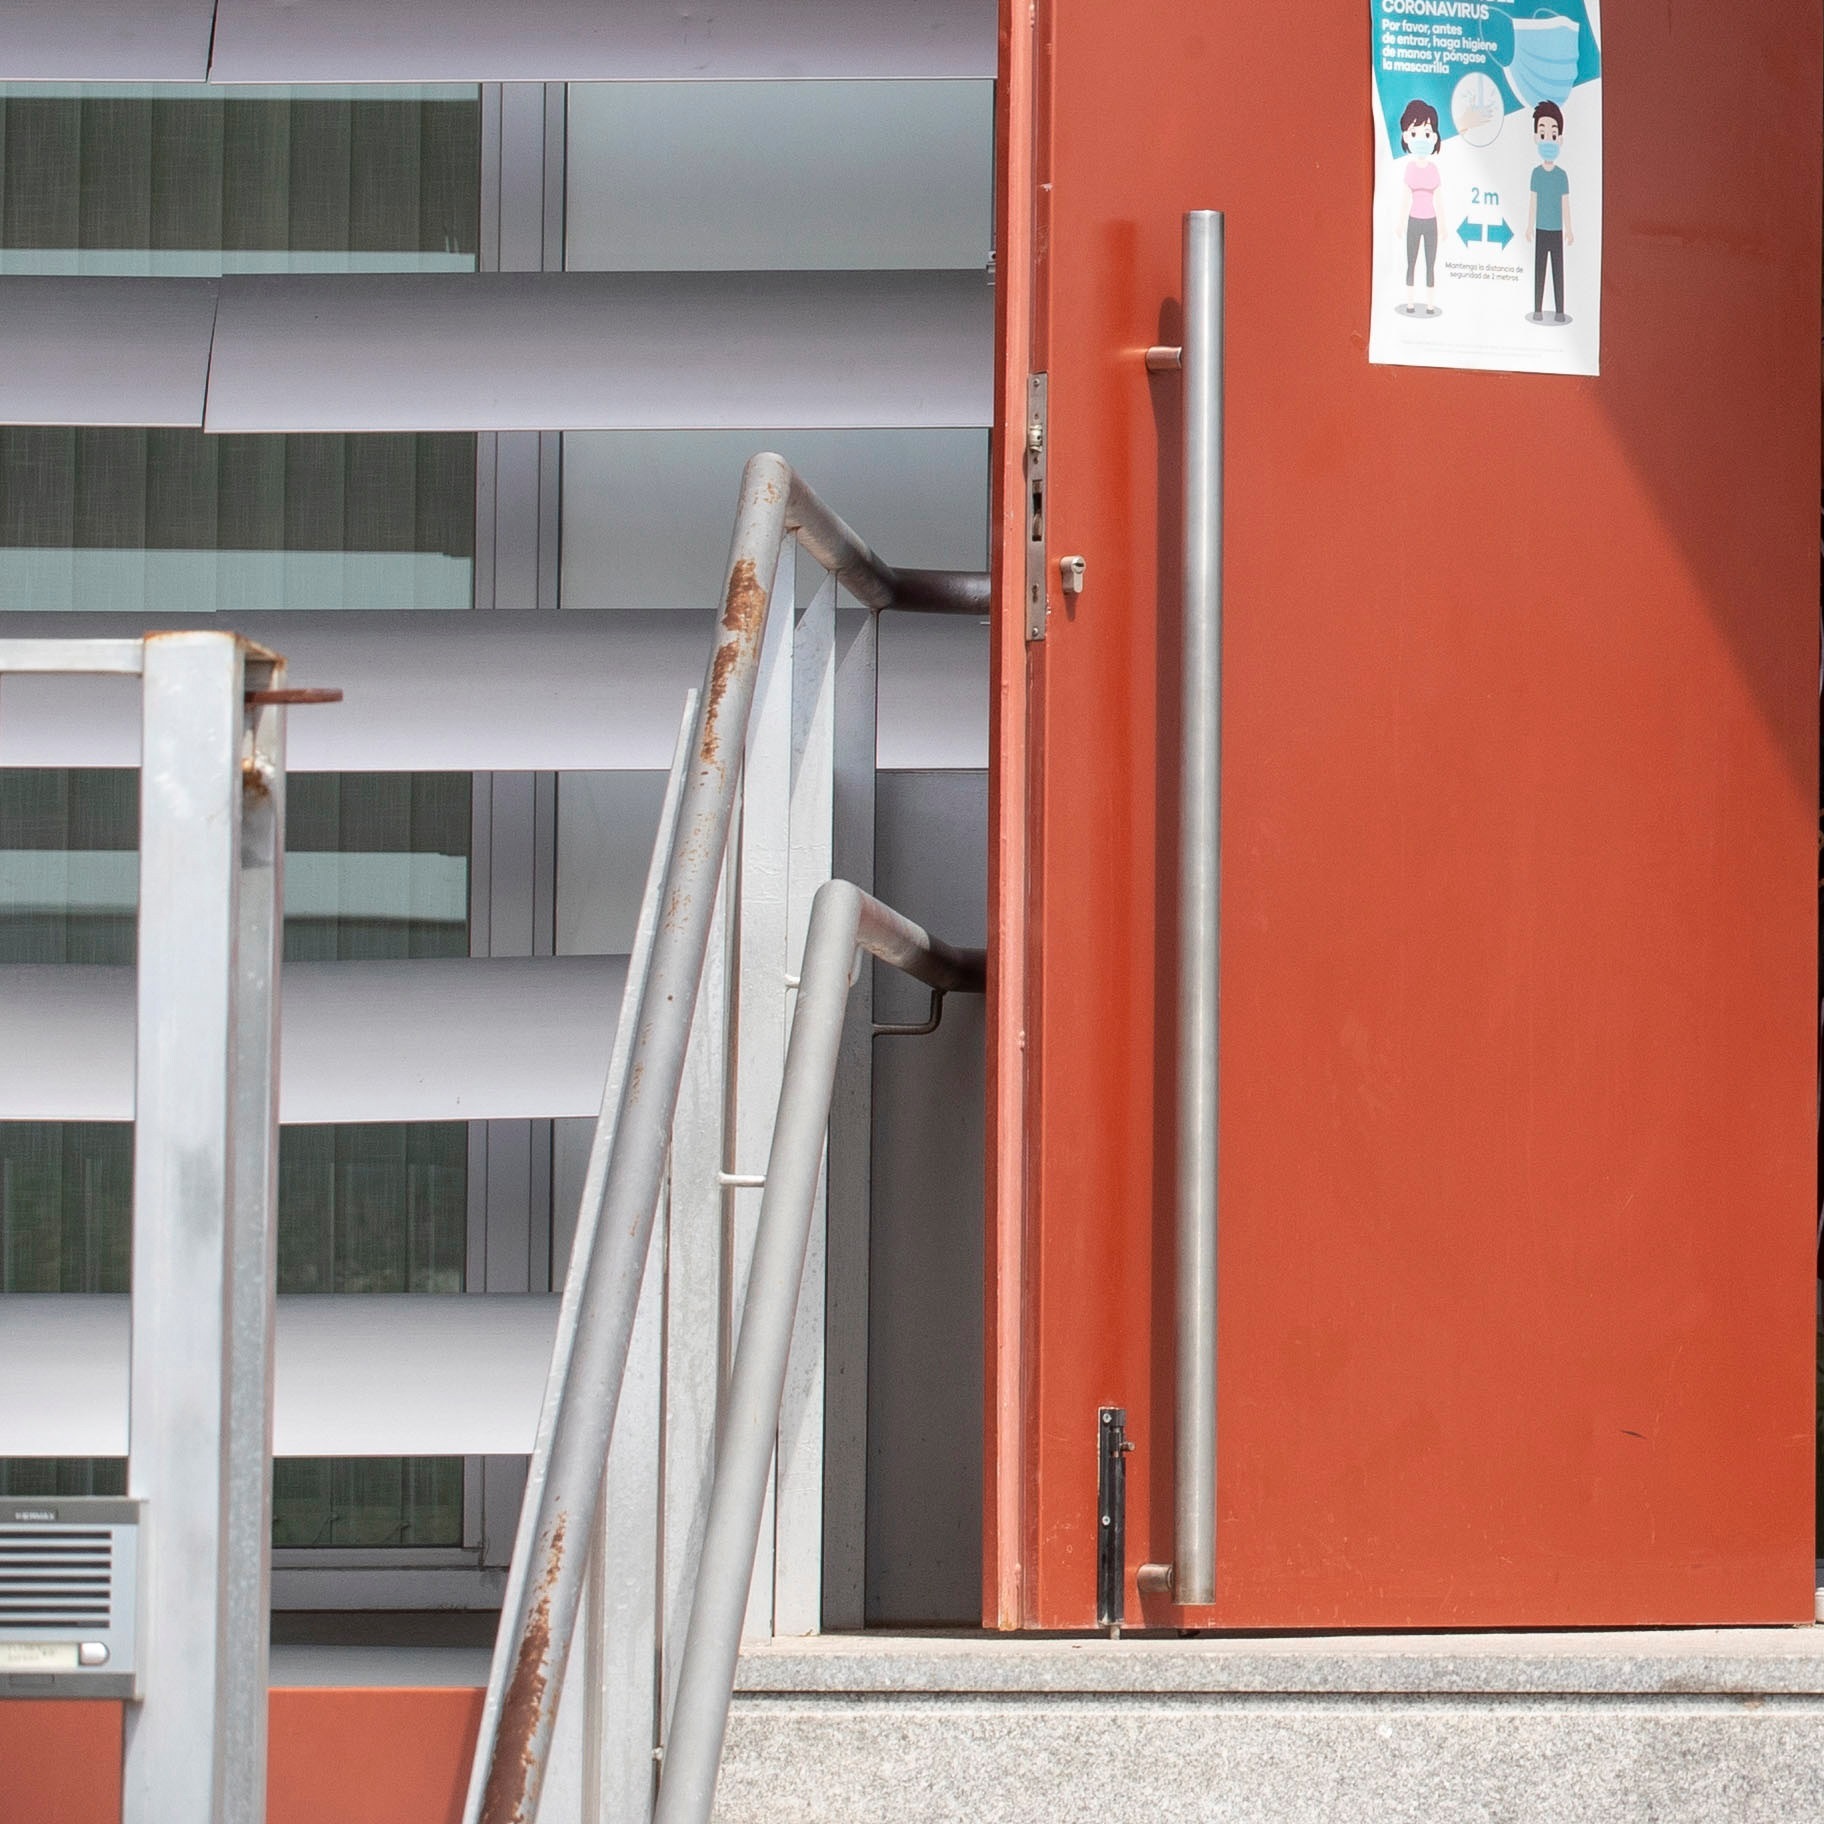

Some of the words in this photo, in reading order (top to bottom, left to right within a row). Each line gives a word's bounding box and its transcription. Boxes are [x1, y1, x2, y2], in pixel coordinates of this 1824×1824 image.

[1382, 19, 1400, 31] Por
[1402, 19, 1431, 35] favor,
[1432, 23, 1462, 35] antes
[1382, 32, 1396, 44] de
[1397, 35, 1432, 48] entrar,
[1433, 36, 1460, 50] haga
[1461, 37, 1498, 52] higiene
[1382, 45, 1396, 57] de
[1397, 48, 1432, 59] manos
[1434, 51, 1441, 63] y
[1443, 49, 1486, 64] póngase
[1382, 58, 1393, 70] la
[1394, 60, 1450, 74] mascarilla
[1471, 187, 1480, 204] 2
[1484, 192, 1500, 206] m
